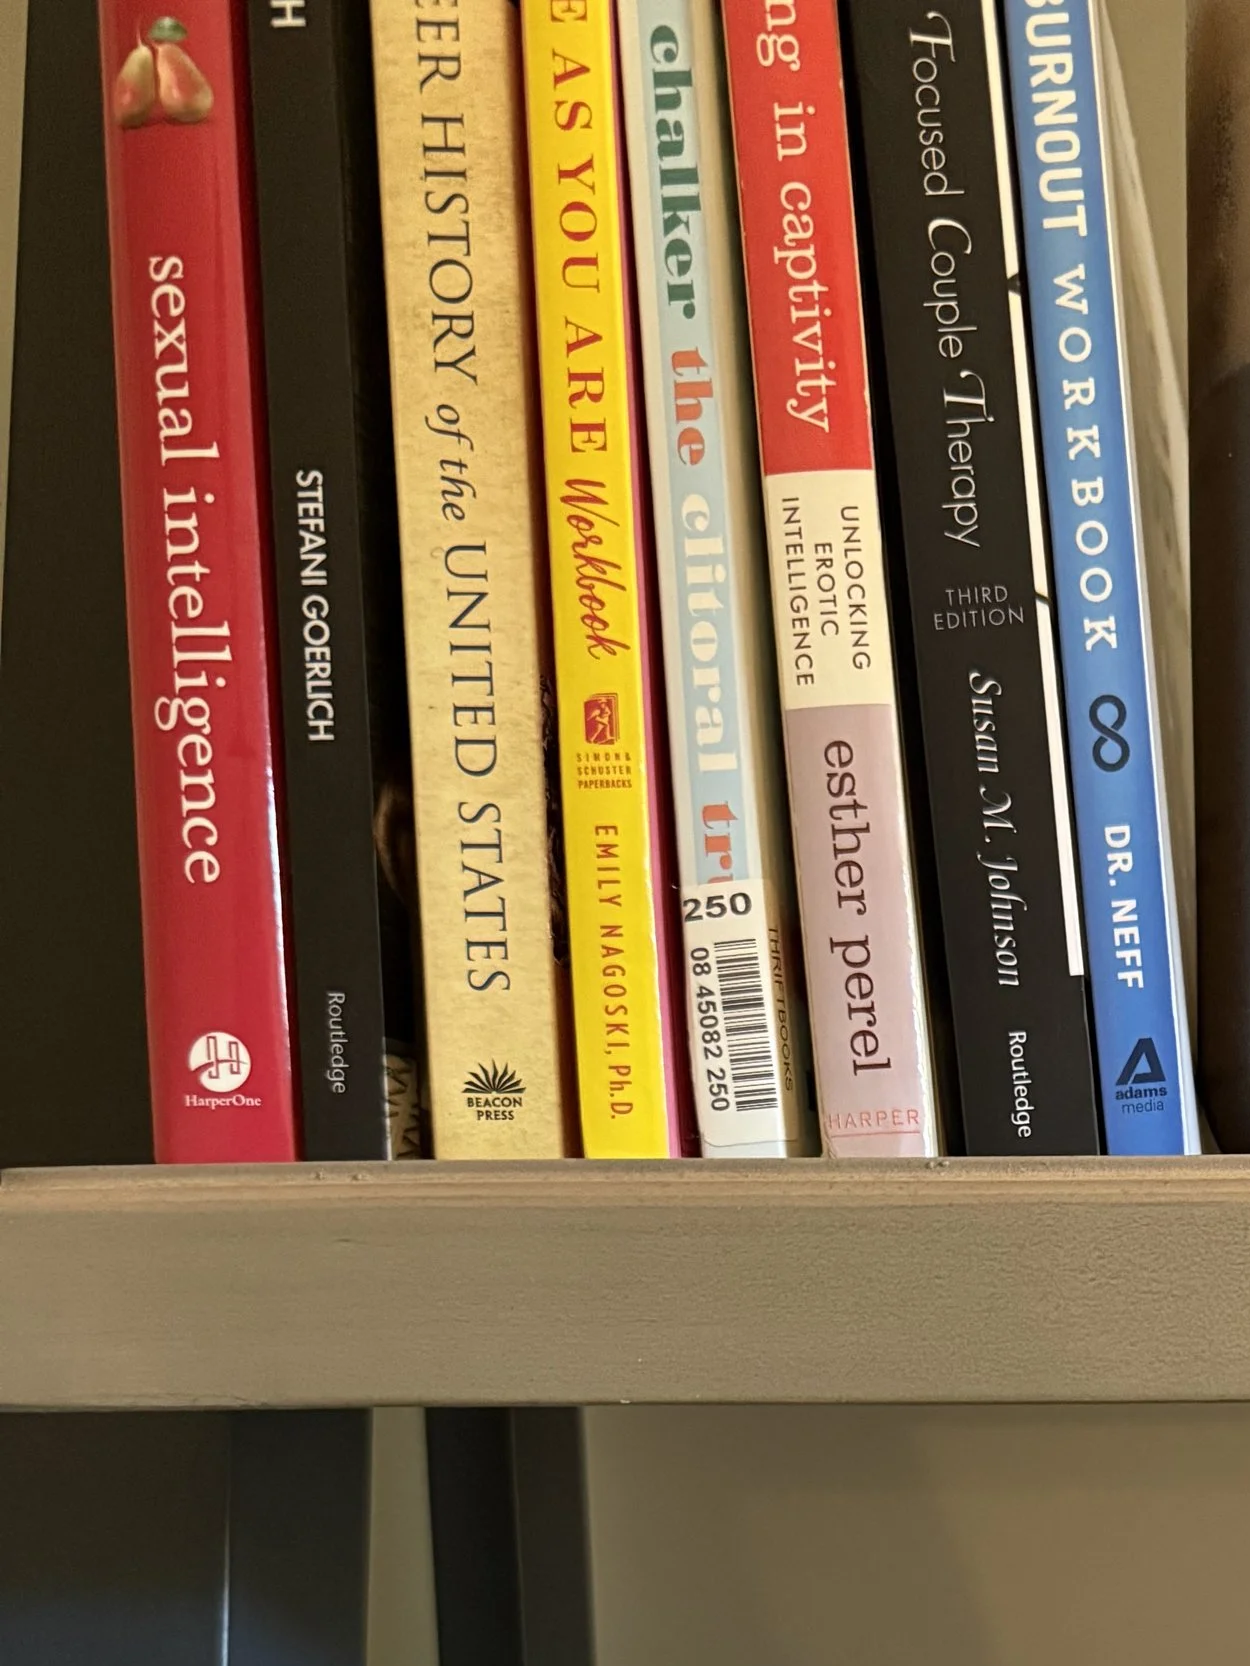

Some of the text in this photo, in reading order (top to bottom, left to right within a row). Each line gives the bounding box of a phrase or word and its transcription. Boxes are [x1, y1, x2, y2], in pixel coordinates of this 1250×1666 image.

[774, 101, 838, 432] in captivity
[909, 10, 995, 548] Focused Couple Therapy
[552, 48, 632, 662] AS YOU ARE Workbook
[649, 23, 737, 772] chalker the clitoral
[1052, 262, 1117, 653] WORKBOOK
[148, 254, 232, 883] sexual intelligence
[295, 469, 335, 742] STEFANI GOERLICH
[420, 113, 511, 992] HISTORY of the UNITED STATES
[781, 497, 813, 685] INTELLIGENCE
[813, 544, 839, 636] EROTIC
[841, 505, 871, 670] UNLOCKING
[933, 606, 1025, 631] EDITION
[945, 584, 1009, 605] THIRD
[577, 765, 632, 776] SCHUSTER
[578, 779, 633, 790] PAPERBACKS
[967, 670, 1028, 987] Susan M. Johnson
[594, 825, 633, 1119] EMILY NAGOSKI, Ph.D.
[683, 892, 752, 922] 250
[824, 738, 891, 1076] esther perel
[1103, 825, 1144, 989] DR. NEFF
[326, 992, 346, 1094] Routledge
[690, 947, 730, 1111] 08 45082 250
[769, 927, 793, 1091] THRIFTBOOKS
[1007, 1030, 1032, 1138] Routledge
[185, 1094, 262, 1108] HarperOne
[466, 1097, 523, 1108] BEACON
[476, 1109, 515, 1120] PRESS
[828, 1109, 919, 1129] HARPER
[1115, 1085, 1167, 1100] adams
[1121, 1099, 1163, 1114] media
